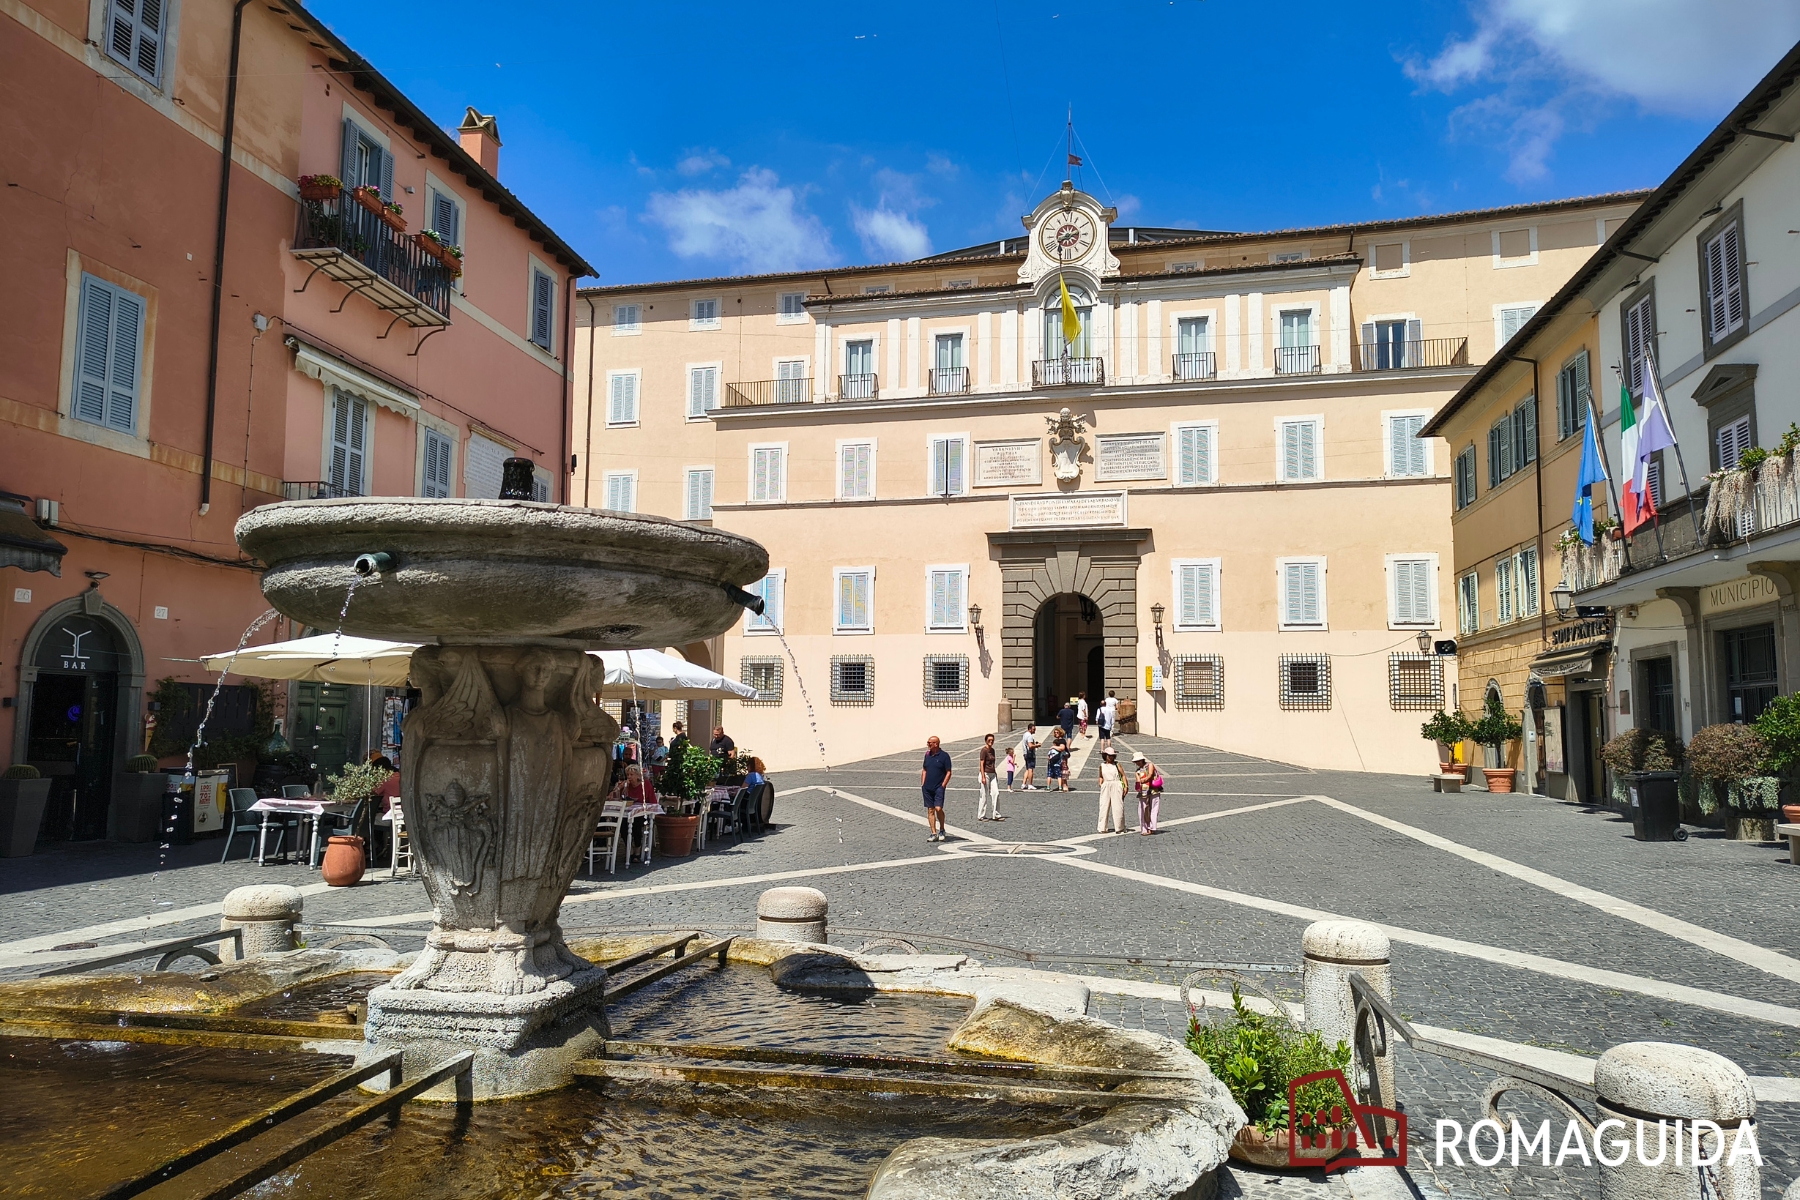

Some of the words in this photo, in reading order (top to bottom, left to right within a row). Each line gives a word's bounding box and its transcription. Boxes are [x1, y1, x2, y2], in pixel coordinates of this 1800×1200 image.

[1710, 577, 1774, 607] MUNICIPIO
[155, 607, 166, 618] 27
[63, 660, 86, 670] BAR
